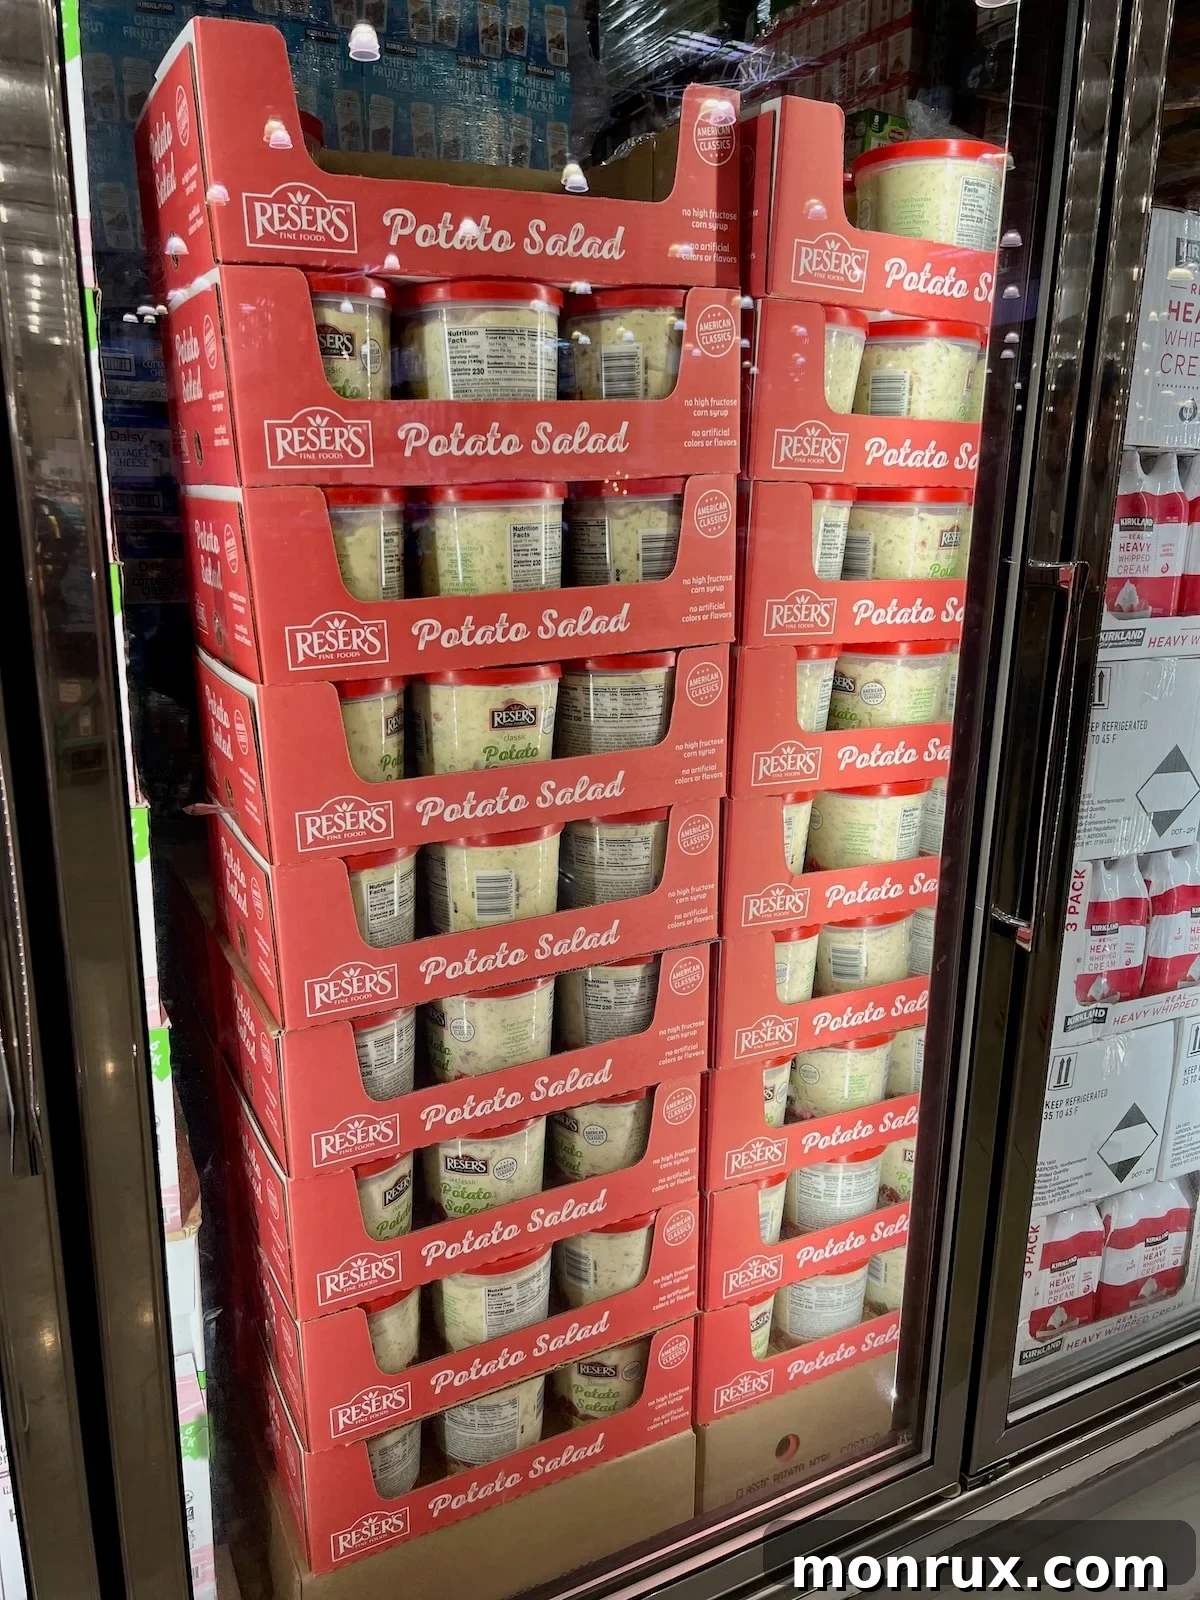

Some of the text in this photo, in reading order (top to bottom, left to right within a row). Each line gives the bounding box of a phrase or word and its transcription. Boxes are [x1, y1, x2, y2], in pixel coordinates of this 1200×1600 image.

[524, 77, 555, 93] CHEESE
[514, 85, 566, 106] FRUIT NUT
[697, 125, 731, 137] AMERICAN
[699, 138, 731, 152] CLASSICS
[253, 201, 350, 243] RESER'S
[279, 232, 326, 242] FINE FOODS
[382, 208, 626, 261] Potato Salad
[798, 246, 863, 283] RESER'S
[884, 258, 970, 299] Potato
[699, 319, 731, 331] AMERICAN
[701, 332, 733, 345] CLASSICS
[472, 367, 485, 376] 230
[181, 366, 204, 404] Salad
[684, 397, 738, 409] no high fructose
[693, 408, 729, 418] corn syrup
[110, 431, 145, 443] Daisy
[398, 420, 630, 457] Potato Salad
[691, 429, 731, 438] no artificial
[275, 425, 366, 462] RESER'S
[683, 438, 737, 447] colors or flavors
[779, 435, 842, 464] RESER'S
[299, 452, 344, 460] FINE FOODS
[864, 437, 950, 469] Potato
[697, 501, 728, 516] AMERICAN
[699, 514, 729, 528] CLASSICS
[1120, 518, 1153, 527] KIRKLAND
[1119, 542, 1152, 552] HEAVY
[1118, 554, 1150, 562] WHIPPED
[1116, 564, 1149, 575] CREAM
[770, 602, 832, 631] RESER'S
[852, 598, 937, 626] Potato
[411, 603, 631, 651] Potato Salad
[294, 624, 381, 664] RESER'S
[1099, 630, 1189, 648] KIRKLAND HEAVY
[318, 651, 361, 660] FINE FOODS
[689, 672, 719, 687] AMERICAN
[691, 683, 720, 698] CLASSICS
[494, 708, 536, 727] RESER'S
[1102, 720, 1148, 732] REFRIGERATED
[503, 733, 527, 742] classic
[675, 738, 724, 752] no high fructose
[1101, 734, 1110, 744] 45
[1112, 734, 1117, 743] F
[484, 743, 539, 763] Potato
[683, 748, 716, 758] corn syrup
[837, 740, 919, 771] Potato
[690, 763, 717, 775] artificial
[758, 752, 817, 781] RESER'S
[674, 776, 694, 785] colors
[701, 772, 723, 781] flavors
[415, 770, 625, 826] Potato Salad
[304, 806, 387, 846] RESER'S
[680, 823, 710, 838] AMERICAN
[343, 831, 367, 839] FOODS
[683, 833, 710, 848] CLASSICS
[825, 877, 904, 908] Potato
[1066, 868, 1086, 931] 3 PACK
[748, 892, 806, 922] RESER'S
[1092, 923, 1119, 932] KIRKLAND
[419, 919, 621, 985] Potato Salad
[1090, 943, 1118, 953] HEAVY
[672, 963, 701, 979] AMERICAN
[1088, 961, 1116, 972] CREAM
[313, 970, 393, 1010] RESER'S
[674, 974, 701, 989] CLASSICS
[334, 993, 373, 1005] FINE FOODS
[1165, 993, 1187, 1004] REAL
[812, 1002, 887, 1036] Potato
[1067, 998, 1198, 1025] KIRKLAND HEAVY WHIPPED
[740, 1023, 794, 1054] RESER'S
[1183, 1064, 1197, 1076] KEEP
[1190, 1074, 1197, 1084] TO
[420, 1058, 614, 1131] Potato Salad
[665, 1093, 694, 1111] AMERICAN
[1044, 1088, 1109, 1110] KEEP REFRIGERATED
[667, 1103, 694, 1120] CLASSICS
[1043, 1106, 1079, 1120] 35 TO 45 F
[319, 1120, 394, 1161] RESER'S
[801, 1120, 875, 1154] Potato
[338, 1142, 376, 1156] FINE FOODS
[446, 1157, 487, 1173] RESER'S
[730, 1142, 784, 1175] RESER'S
[440, 1182, 493, 1200] Potato
[420, 1188, 608, 1267] Potato Salad
[665, 1215, 693, 1233] AMERICAN
[667, 1224, 693, 1242] CLASSICS
[796, 1231, 867, 1268] Potato
[1024, 1224, 1041, 1279] 3 PACK
[325, 1257, 396, 1299] RESER'S
[728, 1259, 780, 1292] RESER'S
[1141, 1263, 1165, 1276] CREAM
[1049, 1274, 1076, 1287] HEAVY
[1047, 1290, 1075, 1305] CREAM
[1116, 1313, 1138, 1324] REAL
[1022, 1315, 1150, 1360] KIRKLAND HEAVY WHIPPED
[430, 1311, 610, 1395] Potato Salad
[787, 1342, 858, 1380] Potato
[579, 1363, 617, 1378] RESER'S
[572, 1383, 620, 1400] Potato
[719, 1374, 770, 1408] RESER'S
[337, 1387, 406, 1431] RESER'S
[575, 1399, 618, 1413] Salad
[428, 1433, 605, 1518] Potato Salad
[338, 1513, 405, 1556] RESER'S
